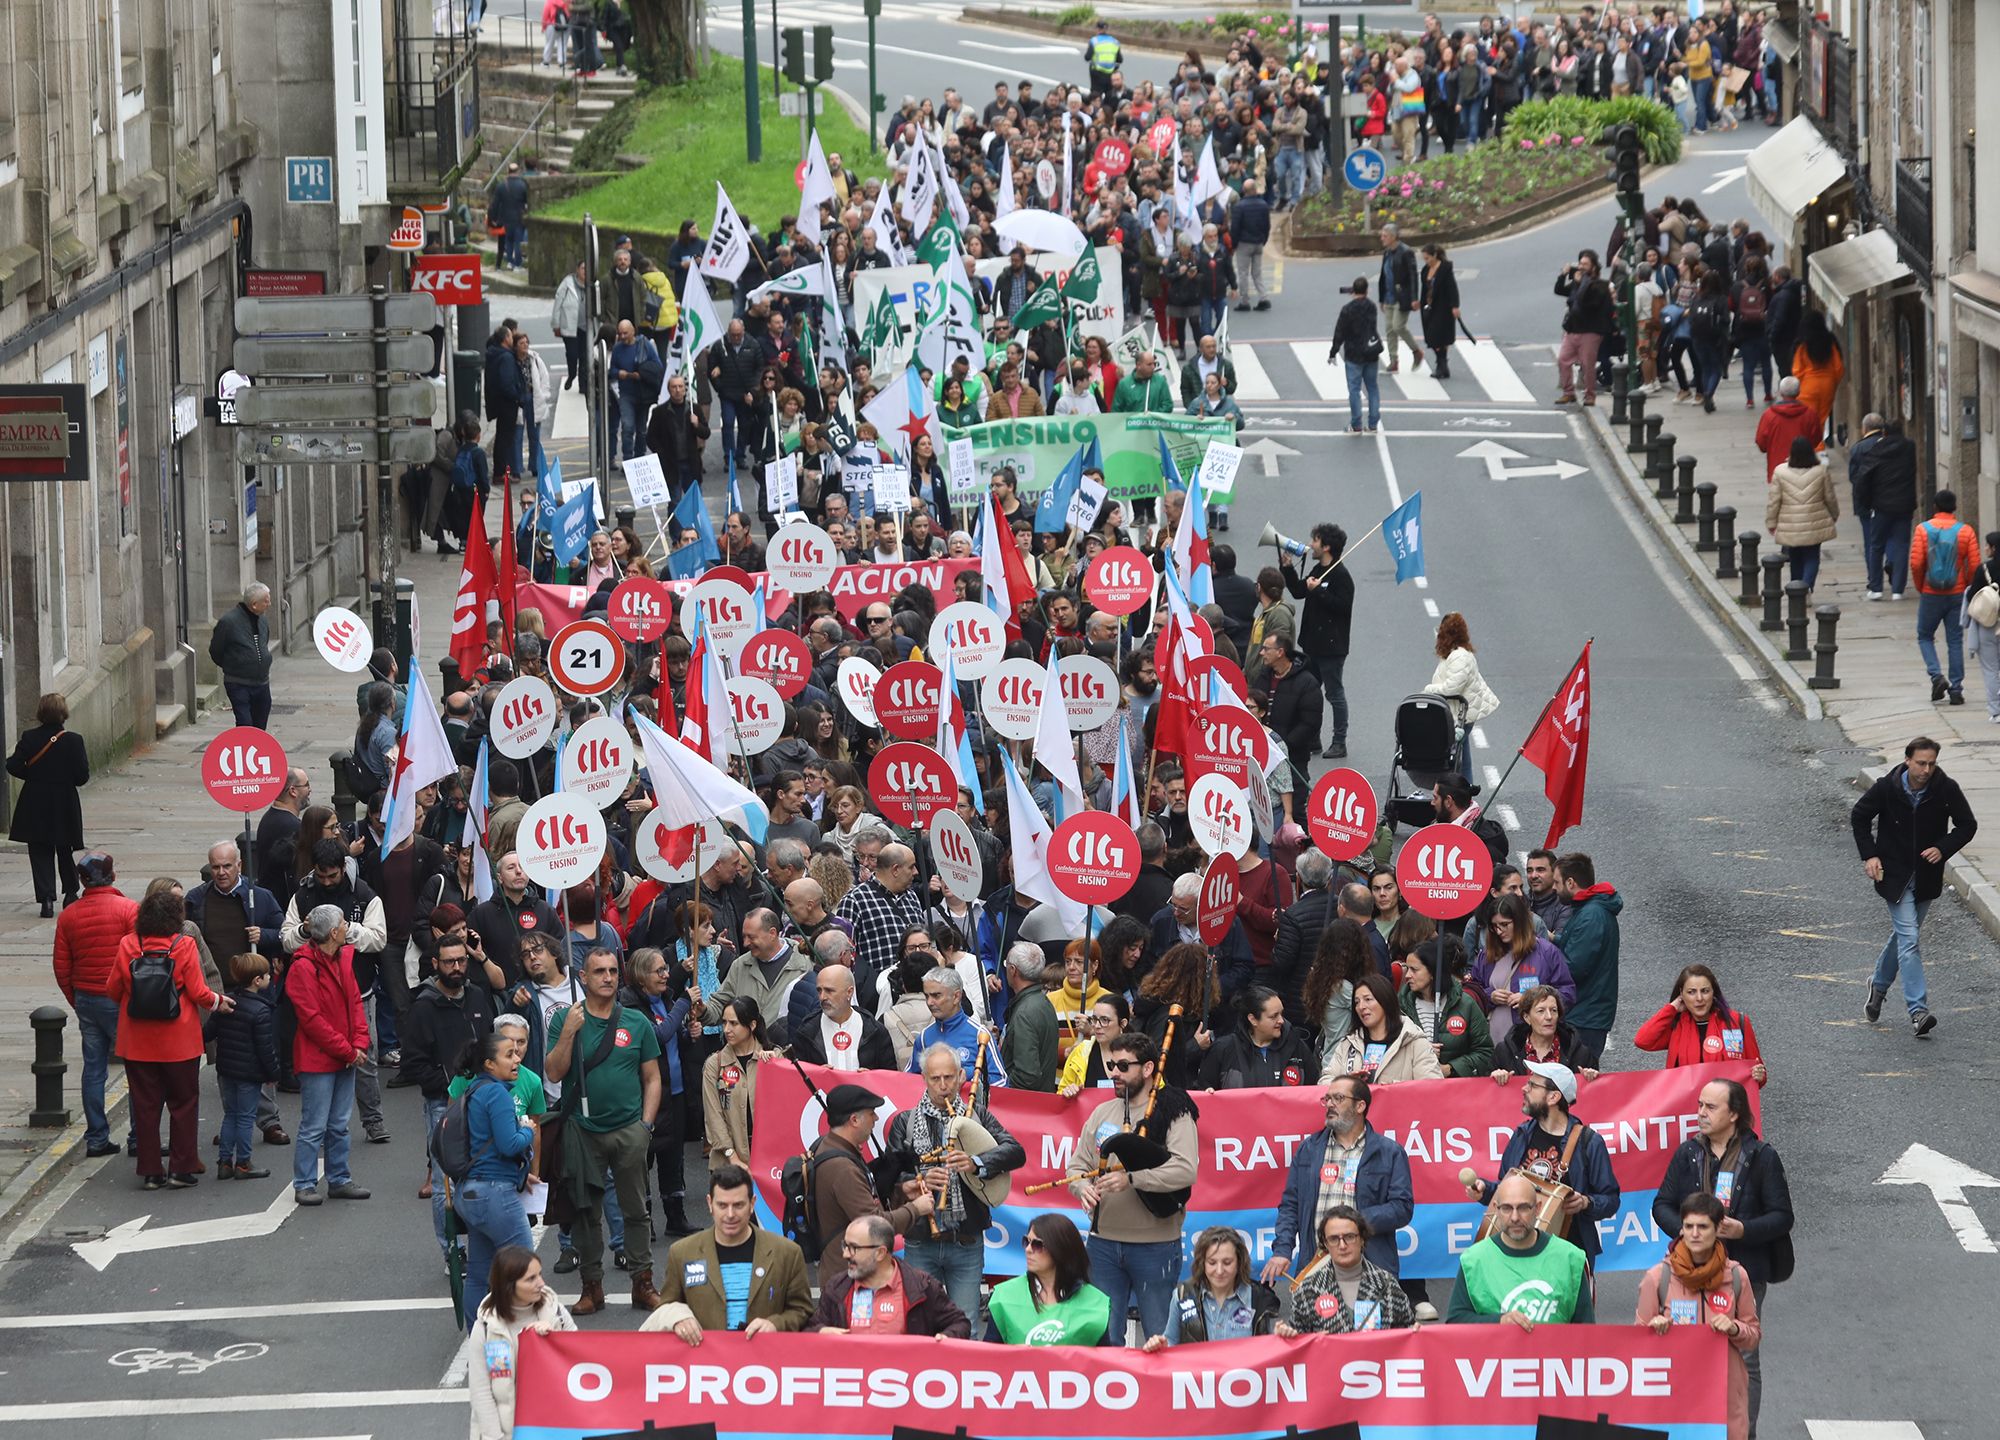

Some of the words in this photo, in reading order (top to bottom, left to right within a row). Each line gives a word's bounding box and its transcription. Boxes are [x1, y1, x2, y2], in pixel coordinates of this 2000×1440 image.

[293, 163, 324, 186] PR
[411, 269, 474, 290] KFC
[218, 401, 237, 412] TA
[220, 412, 238, 423] BE
[0, 424, 62, 441] EMPRA
[971, 419, 1099, 450] ENSINO
[846, 470, 873, 482] STEG
[1208, 461, 1231, 476] XA!
[1069, 503, 1093, 522] STEG
[781, 538, 824, 564] CIG
[1100, 561, 1141, 587] CIG
[622, 592, 660, 617] CIG
[1108, 593, 1131, 601] ENSINO
[323, 620, 355, 653] CIG
[945, 618, 991, 649] CIG
[570, 648, 601, 668] 21
[756, 643, 799, 673] CIG
[958, 653, 983, 664] ENSINO
[890, 678, 940, 707] CIG
[998, 676, 1043, 706] CIG
[1060, 672, 1104, 699] CIG
[502, 693, 543, 730] CIG
[733, 693, 769, 723] IG
[903, 714, 929, 724] ENSINO
[1007, 713, 1031, 723] ENSINO
[1068, 707, 1093, 715] ENSINO
[516, 727, 538, 744] ENSINO
[1204, 722, 1253, 757] CIG
[219, 745, 272, 777] CIG
[577, 737, 620, 774] CIG
[886, 761, 941, 793] CIG
[1214, 763, 1241, 774] ENSINO
[232, 784, 260, 795] ENSINO
[587, 780, 610, 793] ENSINO
[902, 802, 931, 811] ENINO
[1204, 789, 1241, 833] CIG
[1324, 785, 1365, 827] CIG
[535, 813, 588, 851] CIG
[1327, 828, 1350, 843] ENSINO
[941, 828, 972, 866] CIG
[1068, 831, 1124, 868] CIG
[549, 860, 578, 870] ENSINO
[1417, 844, 1474, 881] CIG
[1077, 874, 1108, 886] ENSINO
[1208, 872, 1233, 909] CIG
[1428, 889, 1459, 900] ENSINO
[686, 1274, 706, 1285] STEG
[1510, 1298, 1559, 1323] CSIF
[1033, 1327, 1065, 1342] CSIF
[567, 1362, 613, 1401] O
[645, 1363, 1140, 1410] PROFESORADO
[1171, 1362, 1308, 1410] NON
[1340, 1358, 1425, 1399] SE
[1455, 1357, 1672, 1397] VENDE
